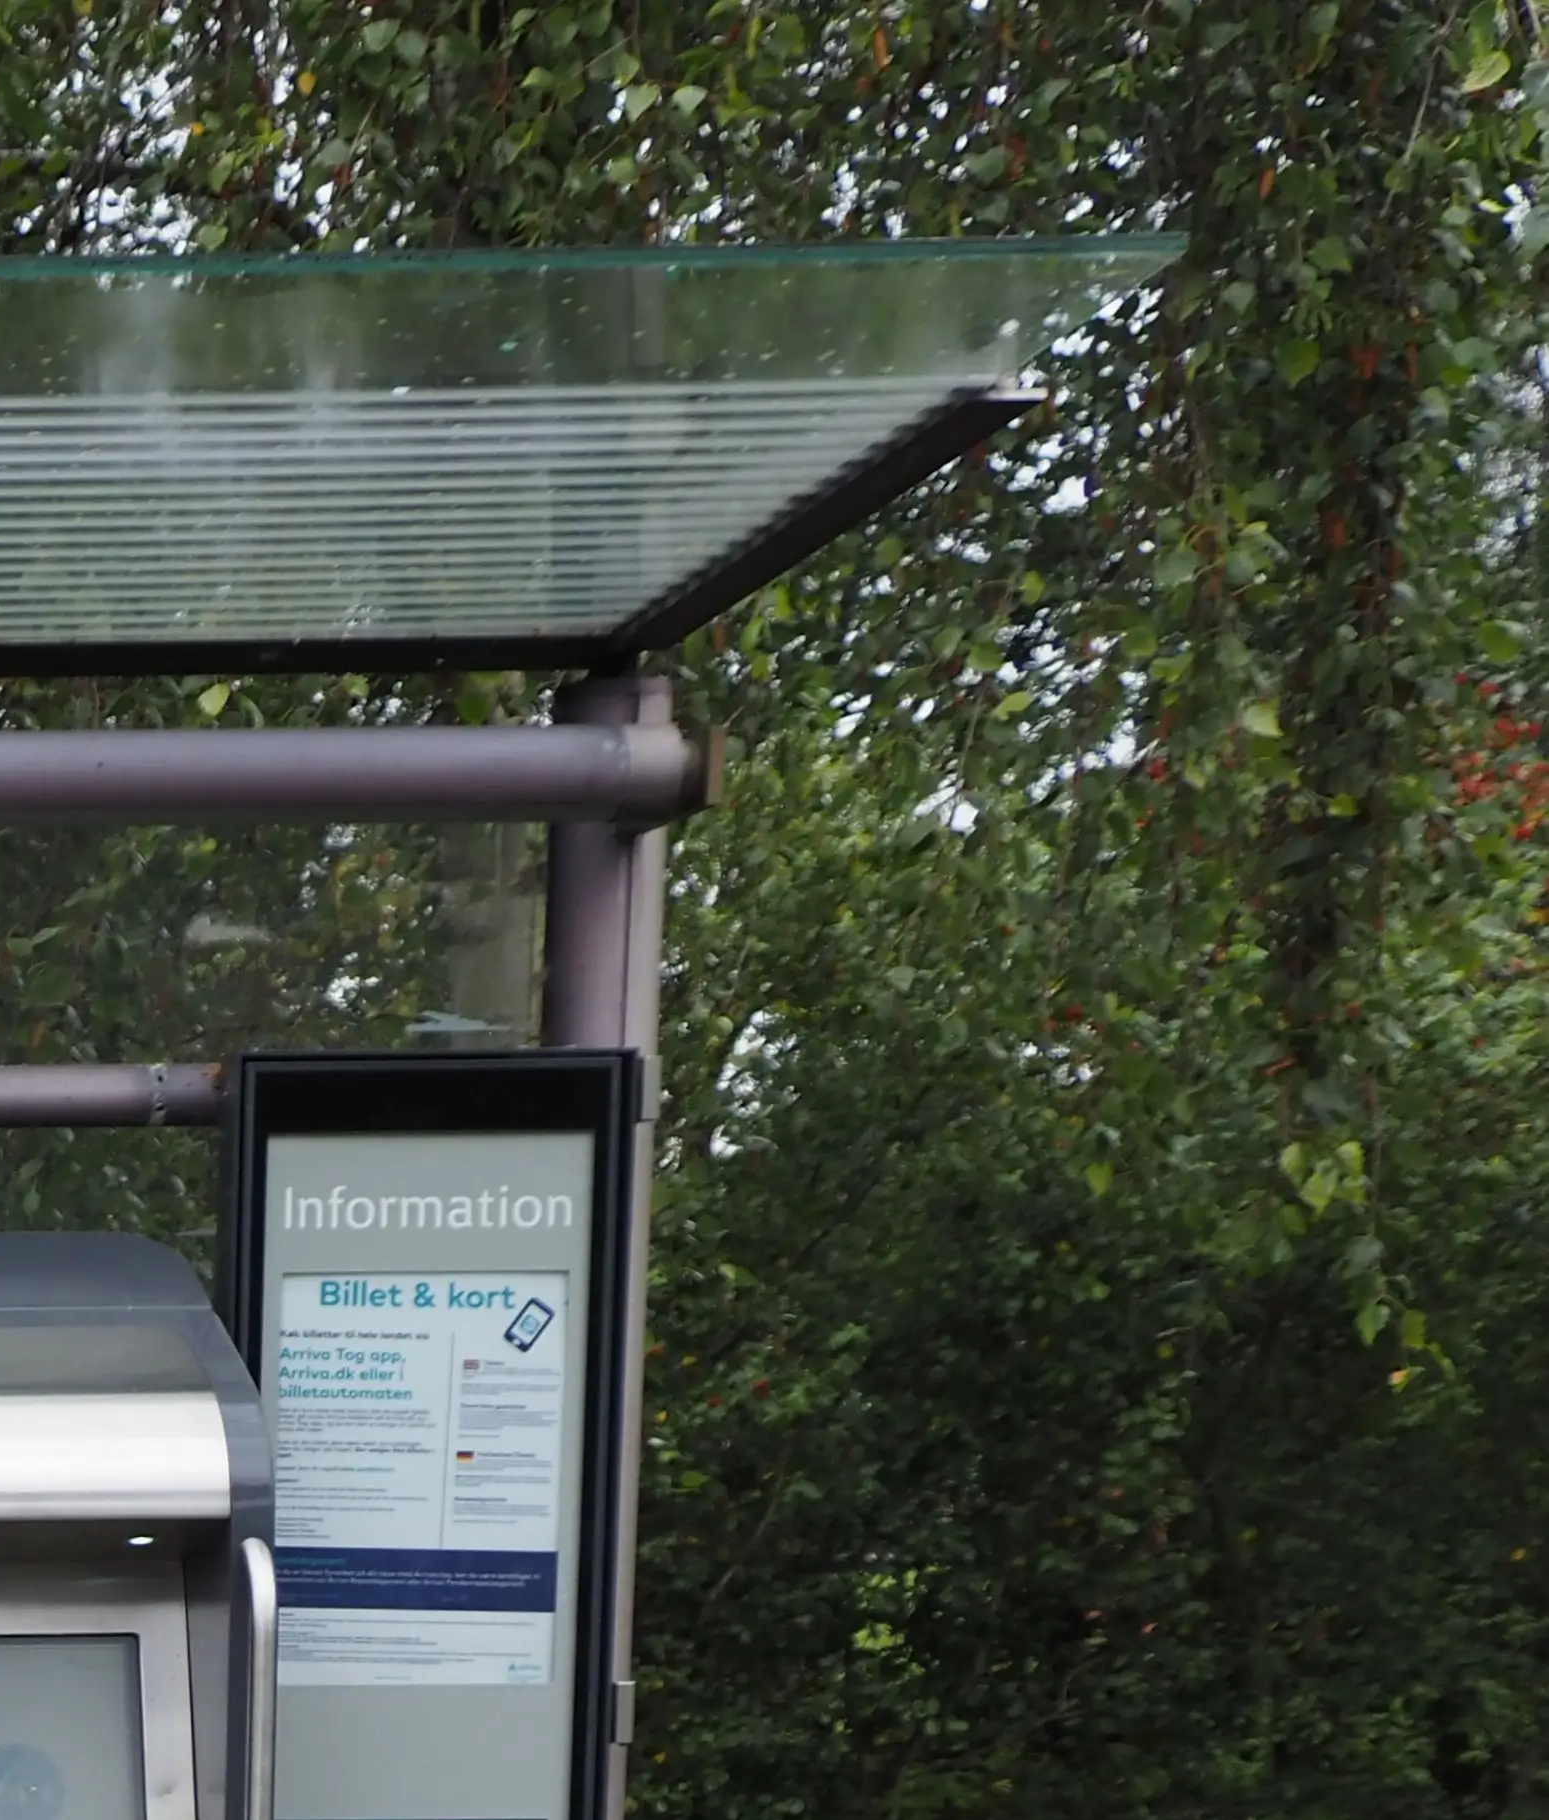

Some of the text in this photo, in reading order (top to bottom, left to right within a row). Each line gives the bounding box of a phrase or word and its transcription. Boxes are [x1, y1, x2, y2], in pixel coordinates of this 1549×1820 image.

[284, 1184, 573, 1229] Information
[319, 1279, 515, 1309] Billet & kort
[279, 1347, 331, 1361] Arriva
[335, 1347, 365, 1364] Tog
[278, 1366, 354, 1380] Arriva.dk
[359, 1367, 395, 1380] eller
[278, 1385, 413, 1399] billetautomaten
